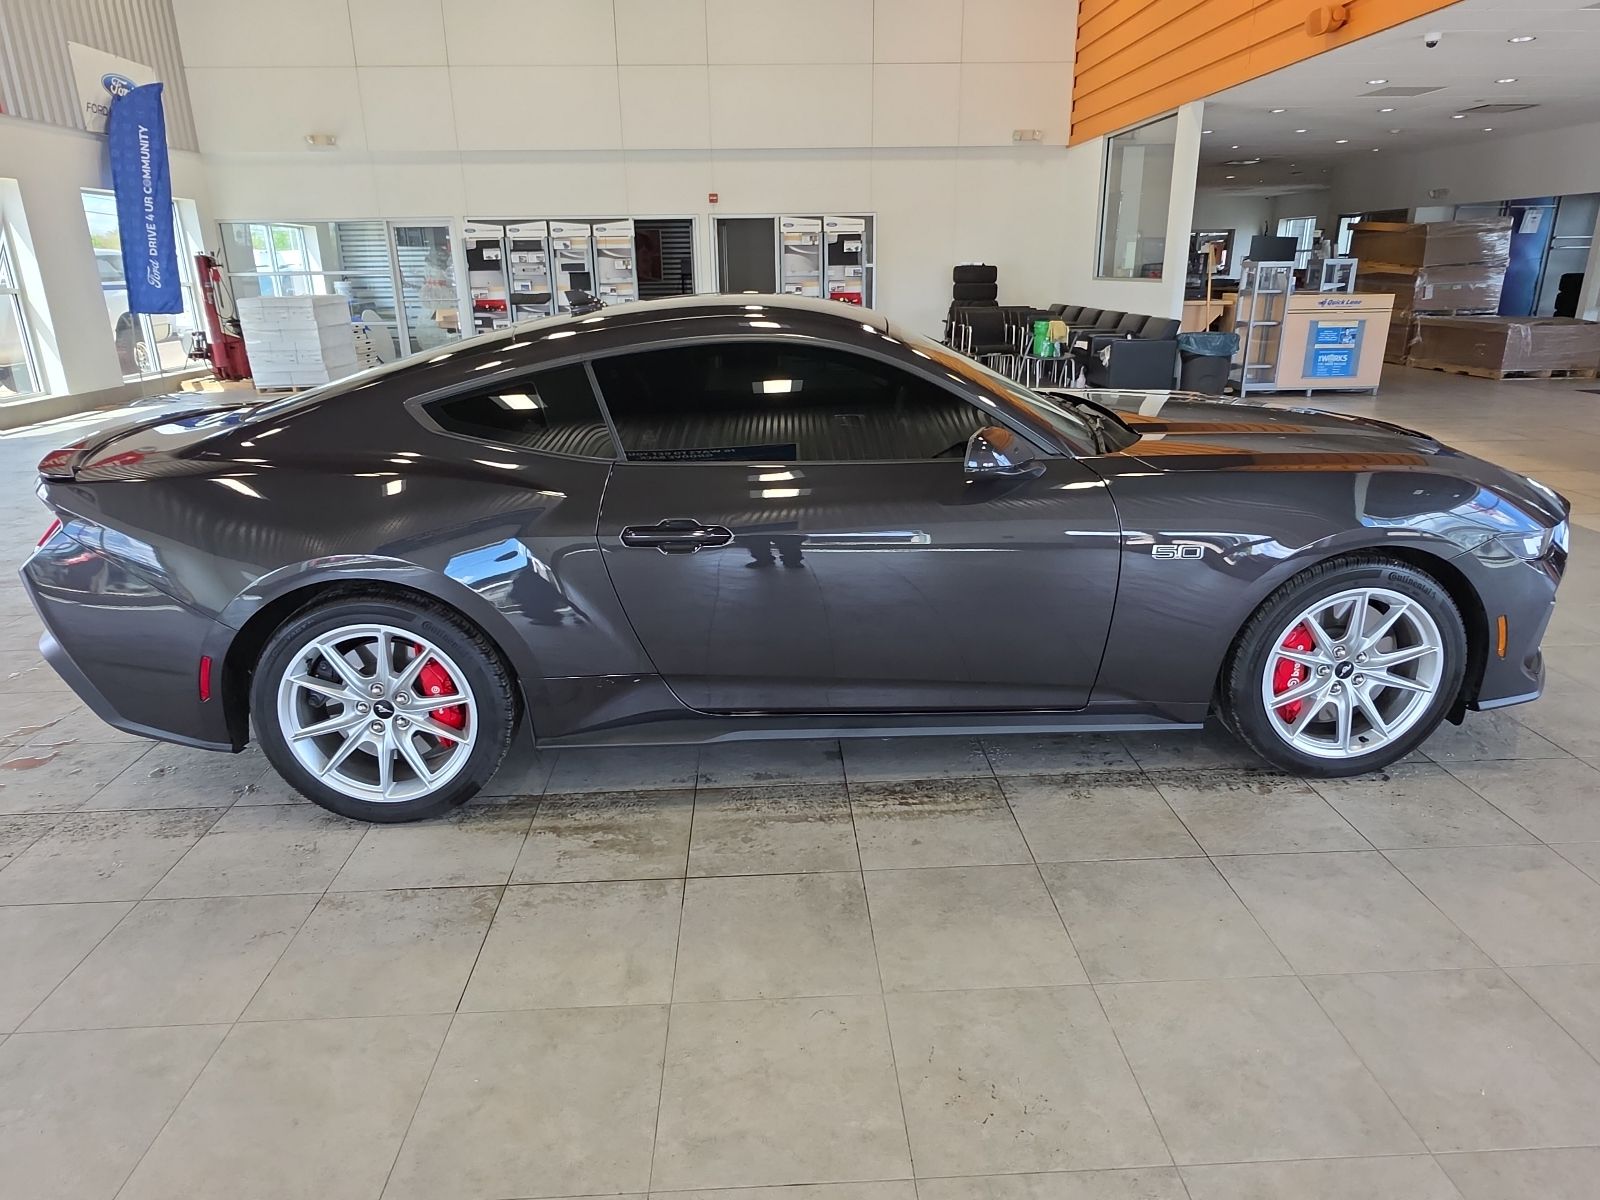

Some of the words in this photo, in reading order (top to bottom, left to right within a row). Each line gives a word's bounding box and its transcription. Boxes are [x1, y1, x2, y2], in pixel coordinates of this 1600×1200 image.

[110, 77, 133, 96] For
[138, 125, 152, 195] COMMUNITY
[144, 196, 155, 212] UR
[145, 213, 155, 222] 4
[145, 223, 159, 256] DRIVE
[147, 258, 162, 289] Ford
[1151, 544, 1205, 560] 5.0
[1388, 571, 1434, 597] Continental
